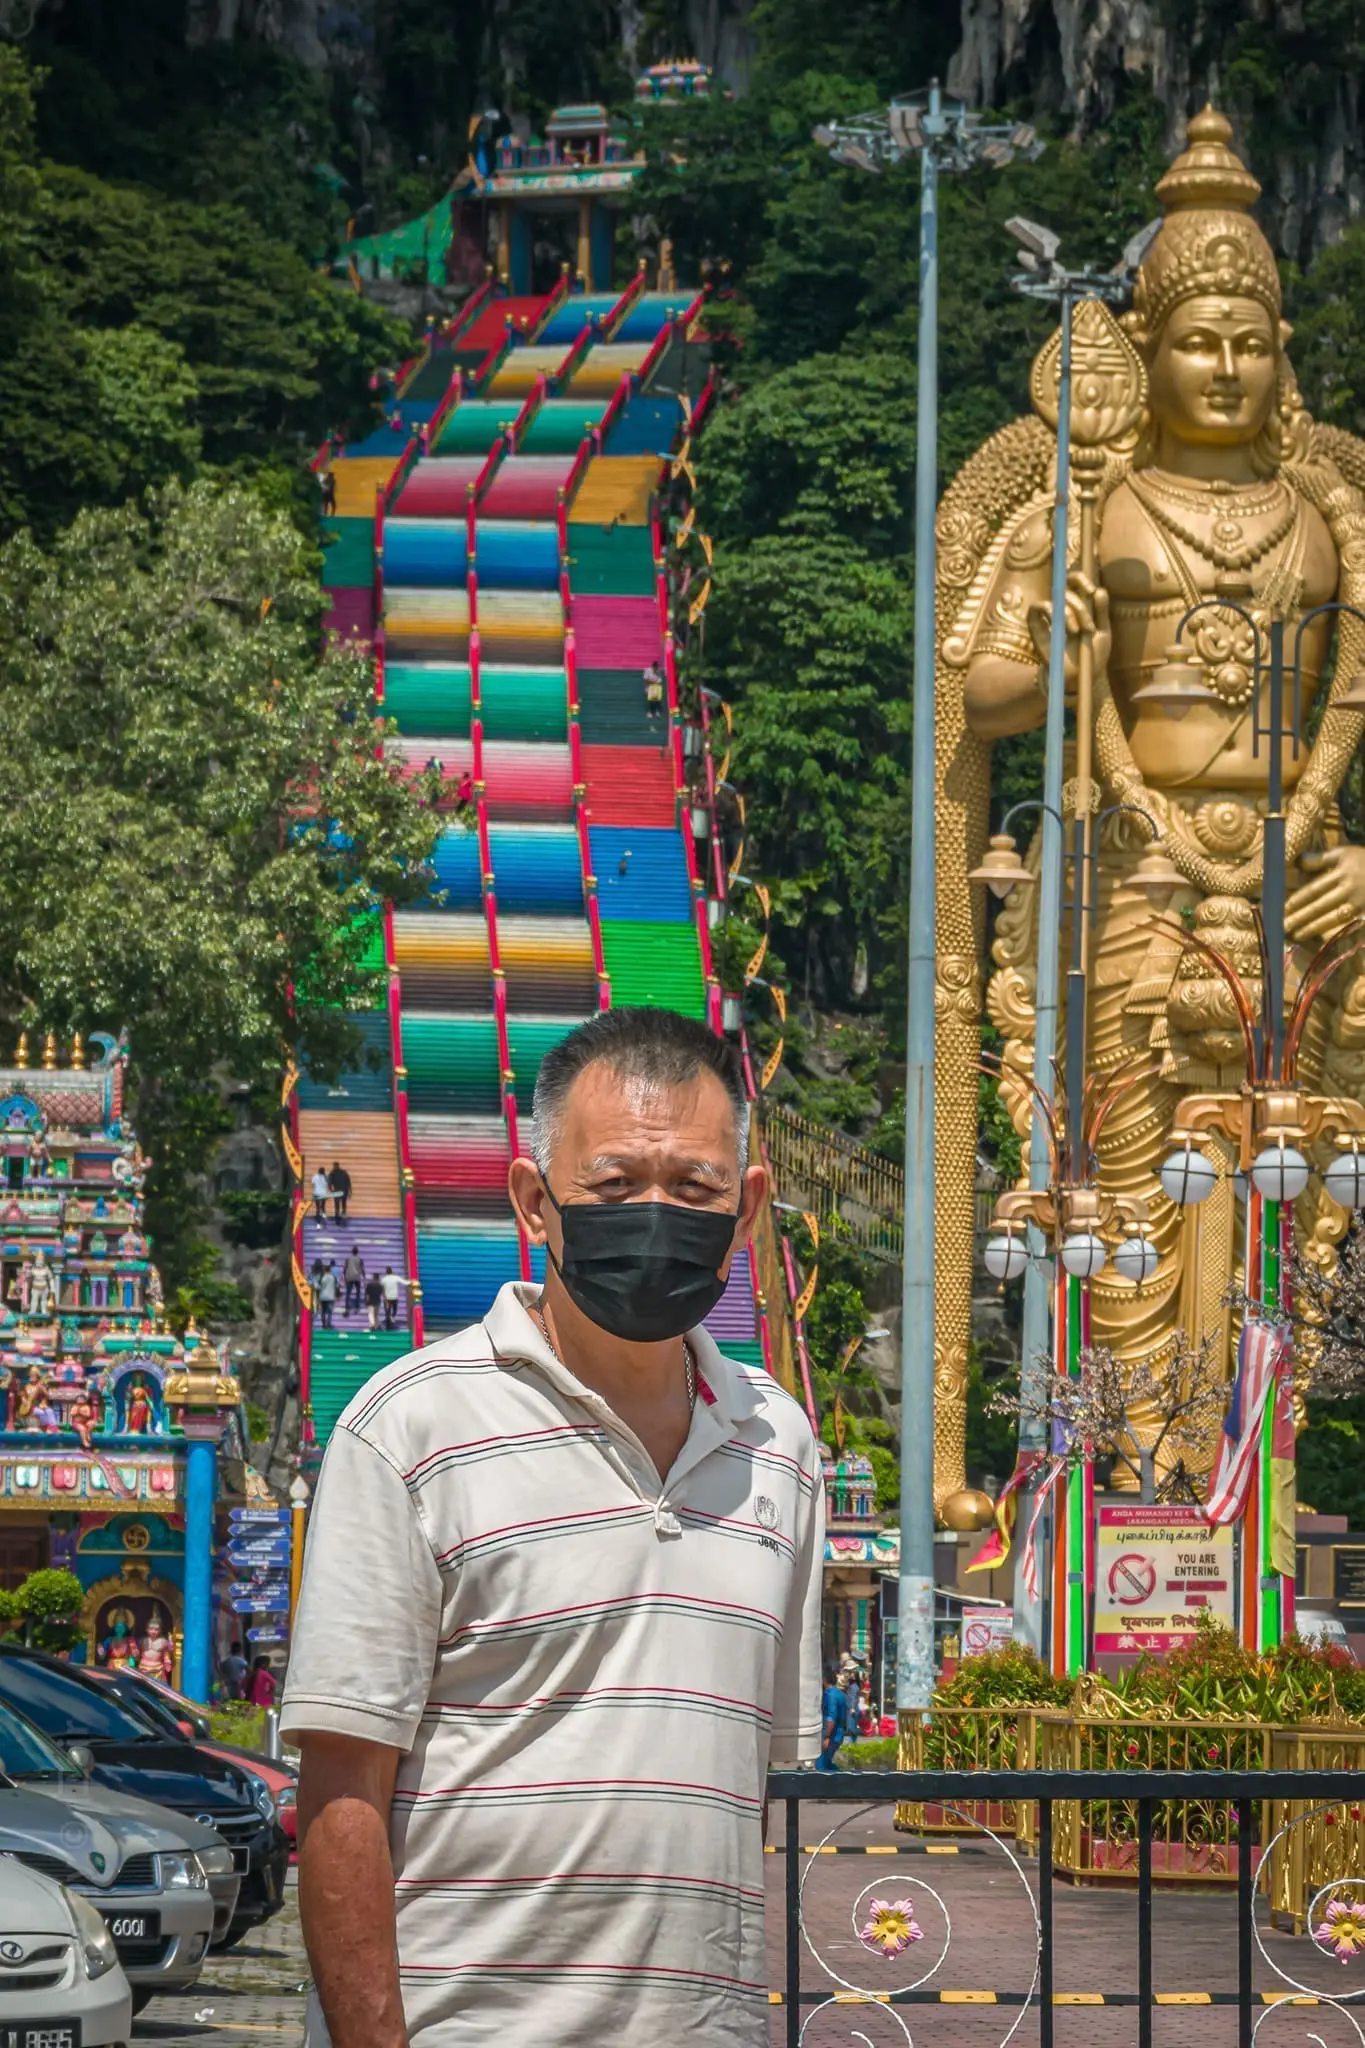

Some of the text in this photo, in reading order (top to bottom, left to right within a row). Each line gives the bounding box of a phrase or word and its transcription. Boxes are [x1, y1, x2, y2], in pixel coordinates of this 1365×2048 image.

[1177, 1553, 1217, 1565] YOU ARE
[1174, 1566, 1220, 1577] ENTERING
